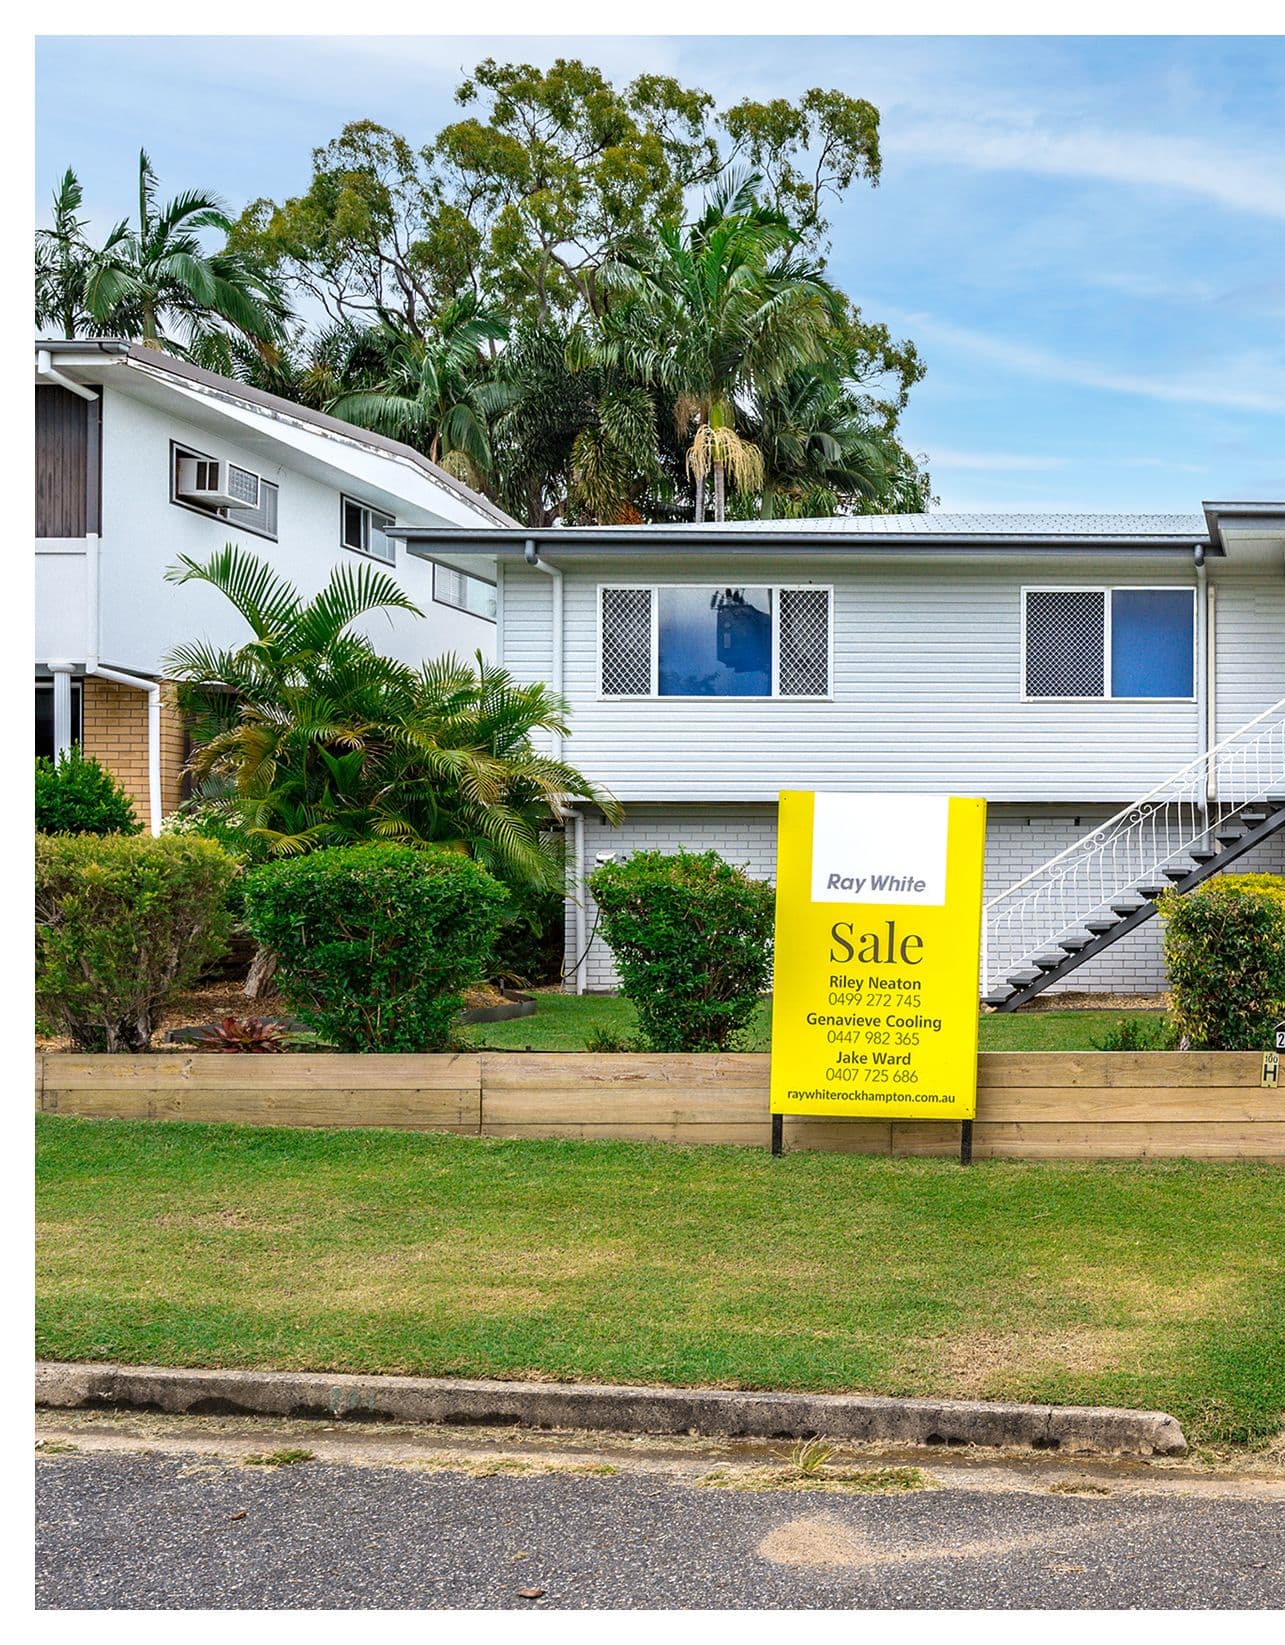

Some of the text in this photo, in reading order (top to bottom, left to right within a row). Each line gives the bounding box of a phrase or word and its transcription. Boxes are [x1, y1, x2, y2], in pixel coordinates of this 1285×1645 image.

[826, 872, 927, 894] Ray White
[829, 920, 924, 966] Sale
[829, 975, 922, 991] Riley Neaton
[828, 992, 921, 1008] 0499 272 745
[806, 1012, 942, 1032] Genavieve Cooling
[827, 1030, 920, 1046] 0447 982 365
[836, 1050, 912, 1066] Jake Ward
[826, 1067, 919, 1084] 0407 725 686
[1263, 1064, 1277, 1081] H
[787, 1088, 956, 1104] raywhiterockhampton.com.au
